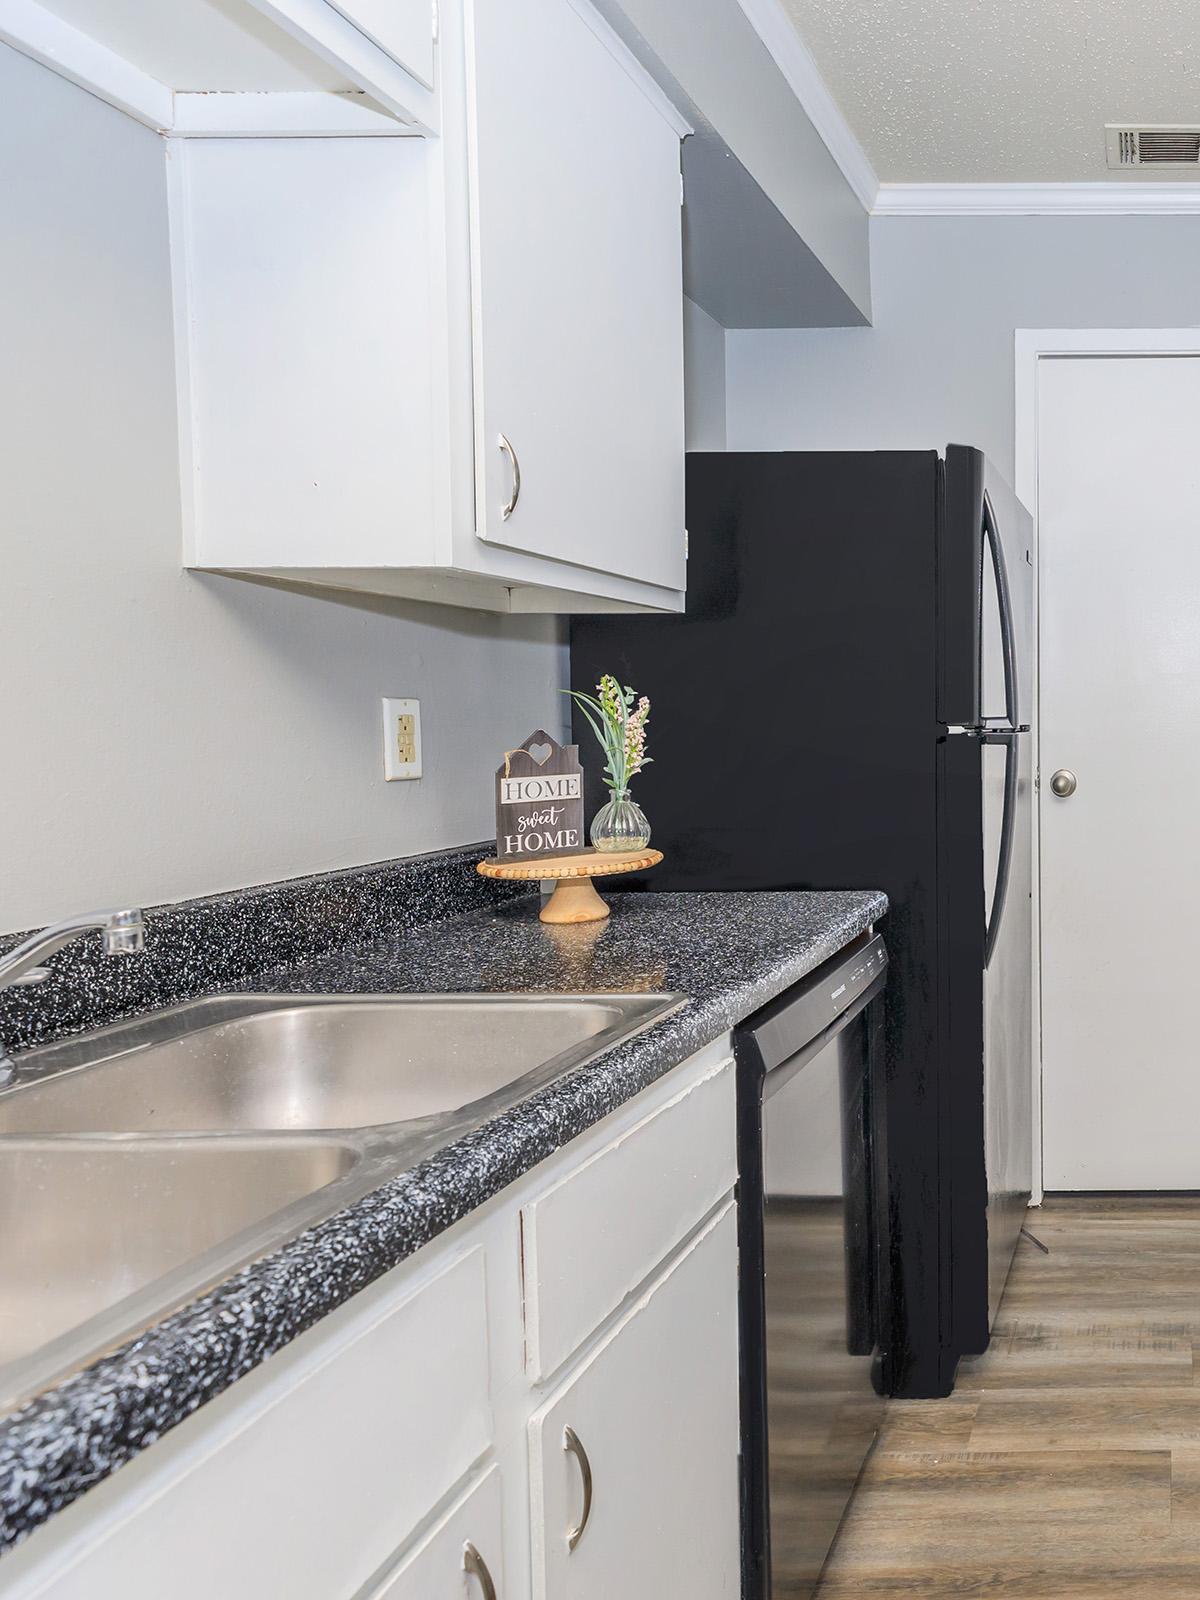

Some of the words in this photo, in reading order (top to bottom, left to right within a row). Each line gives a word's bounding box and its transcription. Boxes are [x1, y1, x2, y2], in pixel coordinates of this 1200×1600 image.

[505, 779, 579, 801] HOME
[518, 806, 565, 832] sweet
[504, 829, 579, 854] HOME
